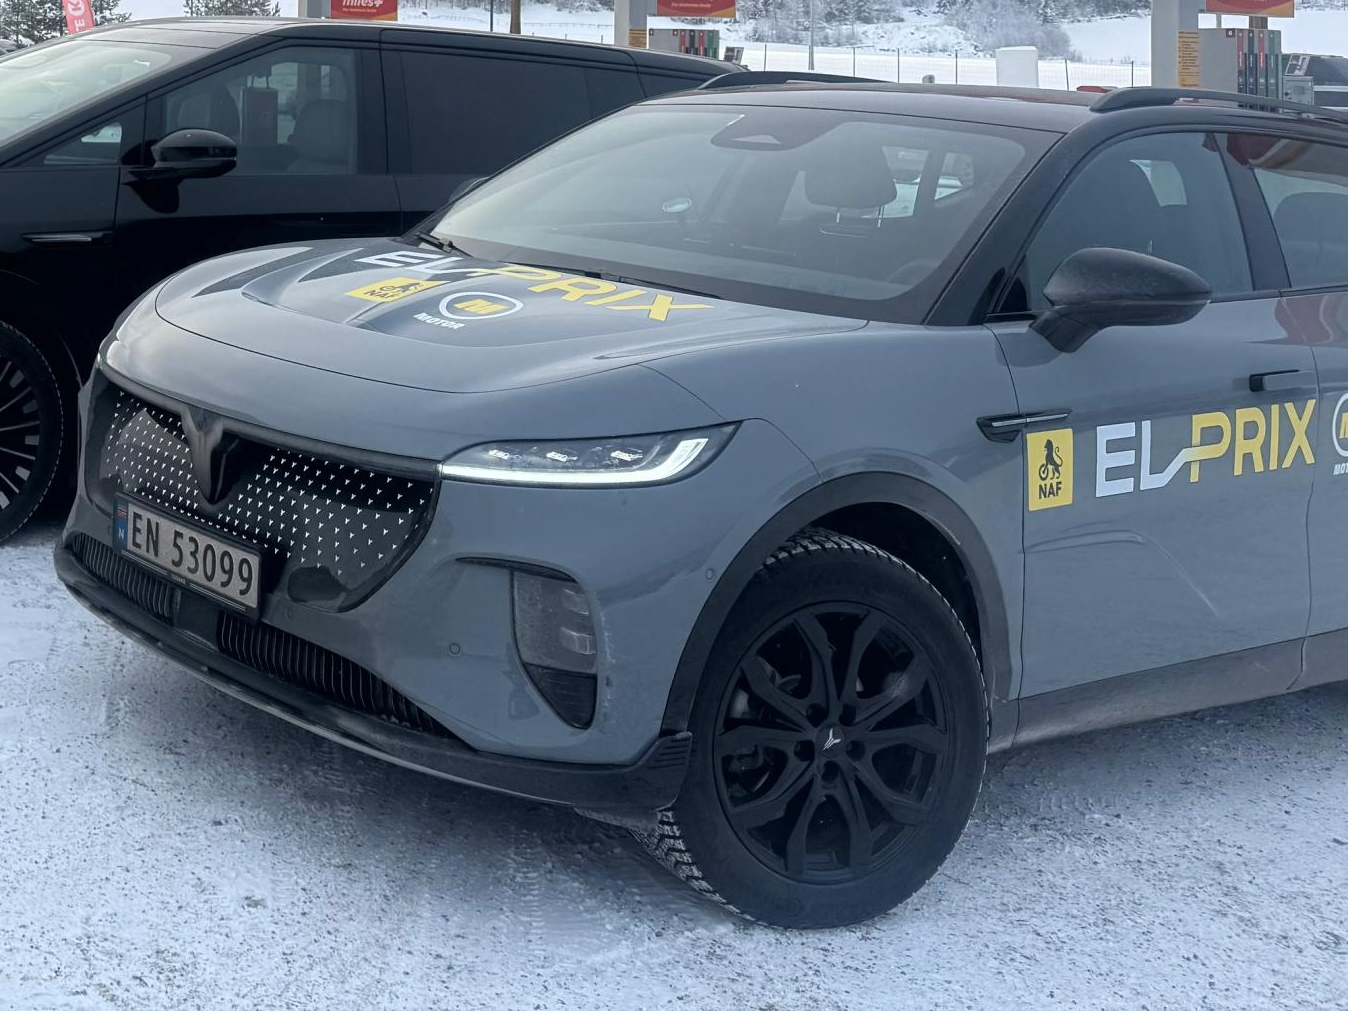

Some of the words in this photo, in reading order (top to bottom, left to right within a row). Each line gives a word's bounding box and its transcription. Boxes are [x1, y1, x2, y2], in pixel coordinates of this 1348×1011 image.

[413, 312, 466, 330] MOTOR
[1038, 481, 1062, 500] NAF
[118, 527, 125, 540] N
[131, 511, 160, 558] EN
[171, 529, 253, 596] 53099
